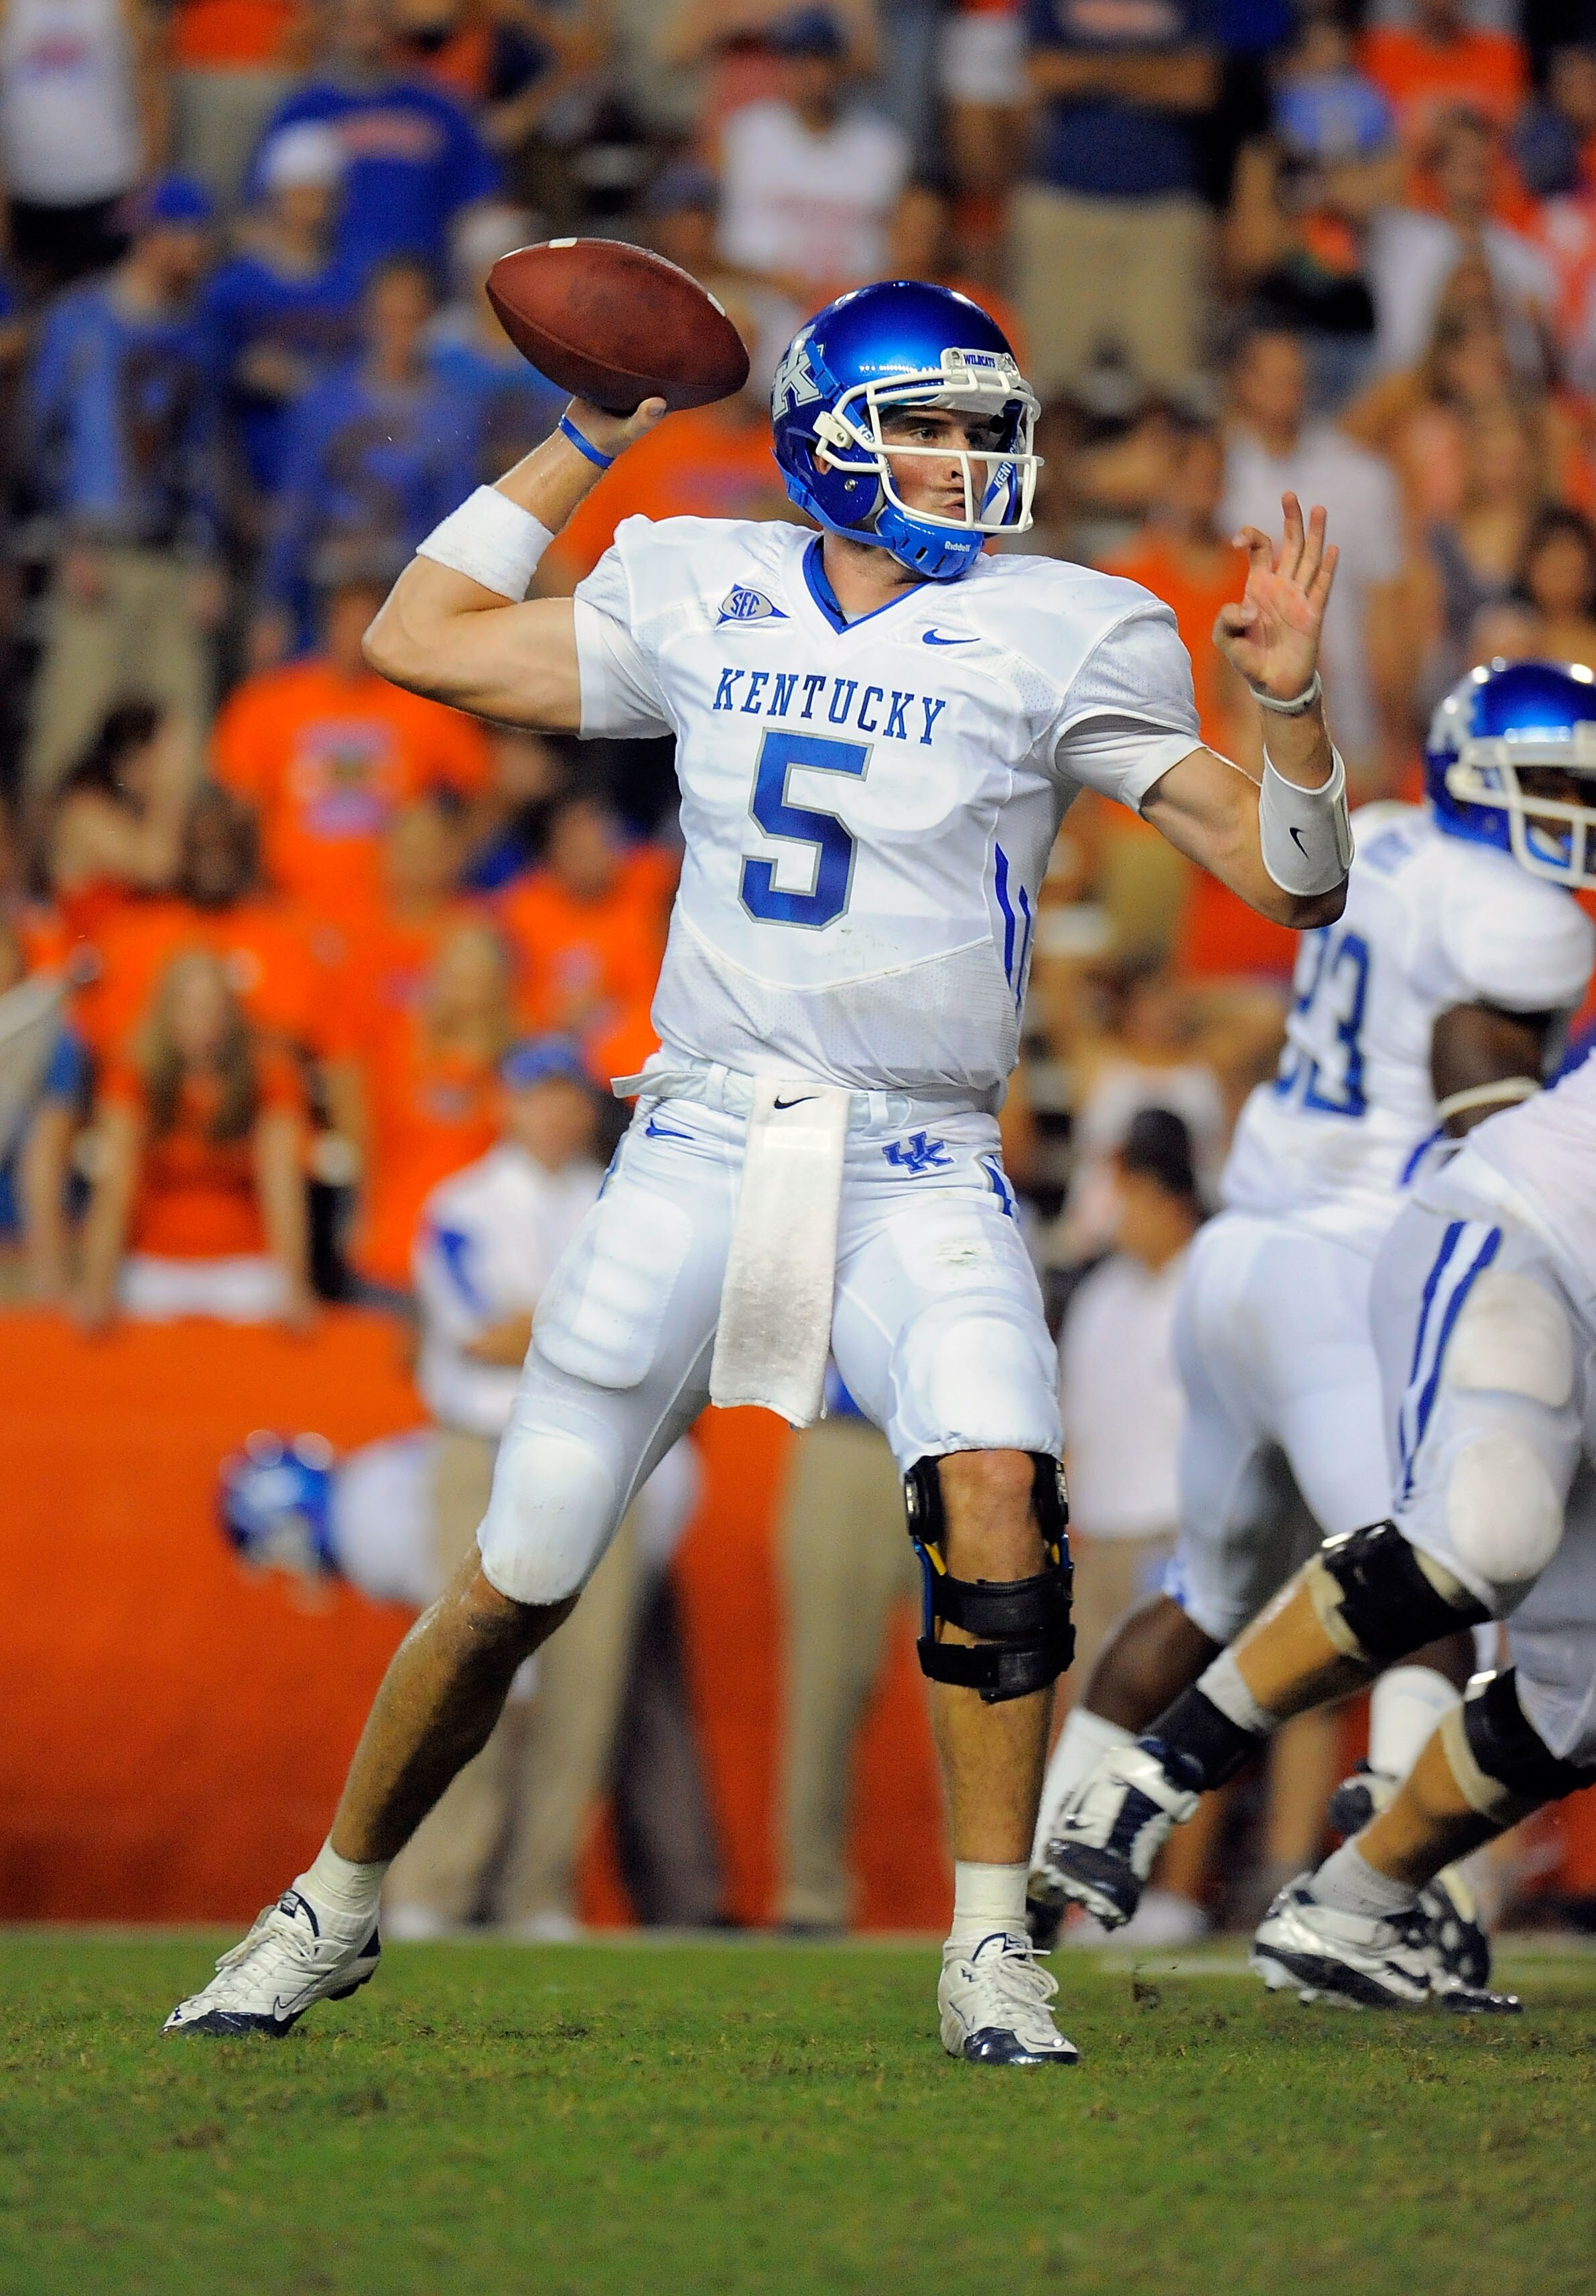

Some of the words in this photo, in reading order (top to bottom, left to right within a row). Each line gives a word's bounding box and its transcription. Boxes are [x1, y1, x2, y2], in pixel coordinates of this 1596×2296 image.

[963, 354, 996, 368] WILDCATS
[945, 540, 972, 552] Riddell
[730, 591, 760, 617] SEC
[713, 667, 946, 746] KENTUCKY
[738, 726, 874, 932] 5
[882, 1131, 955, 1174] UK
